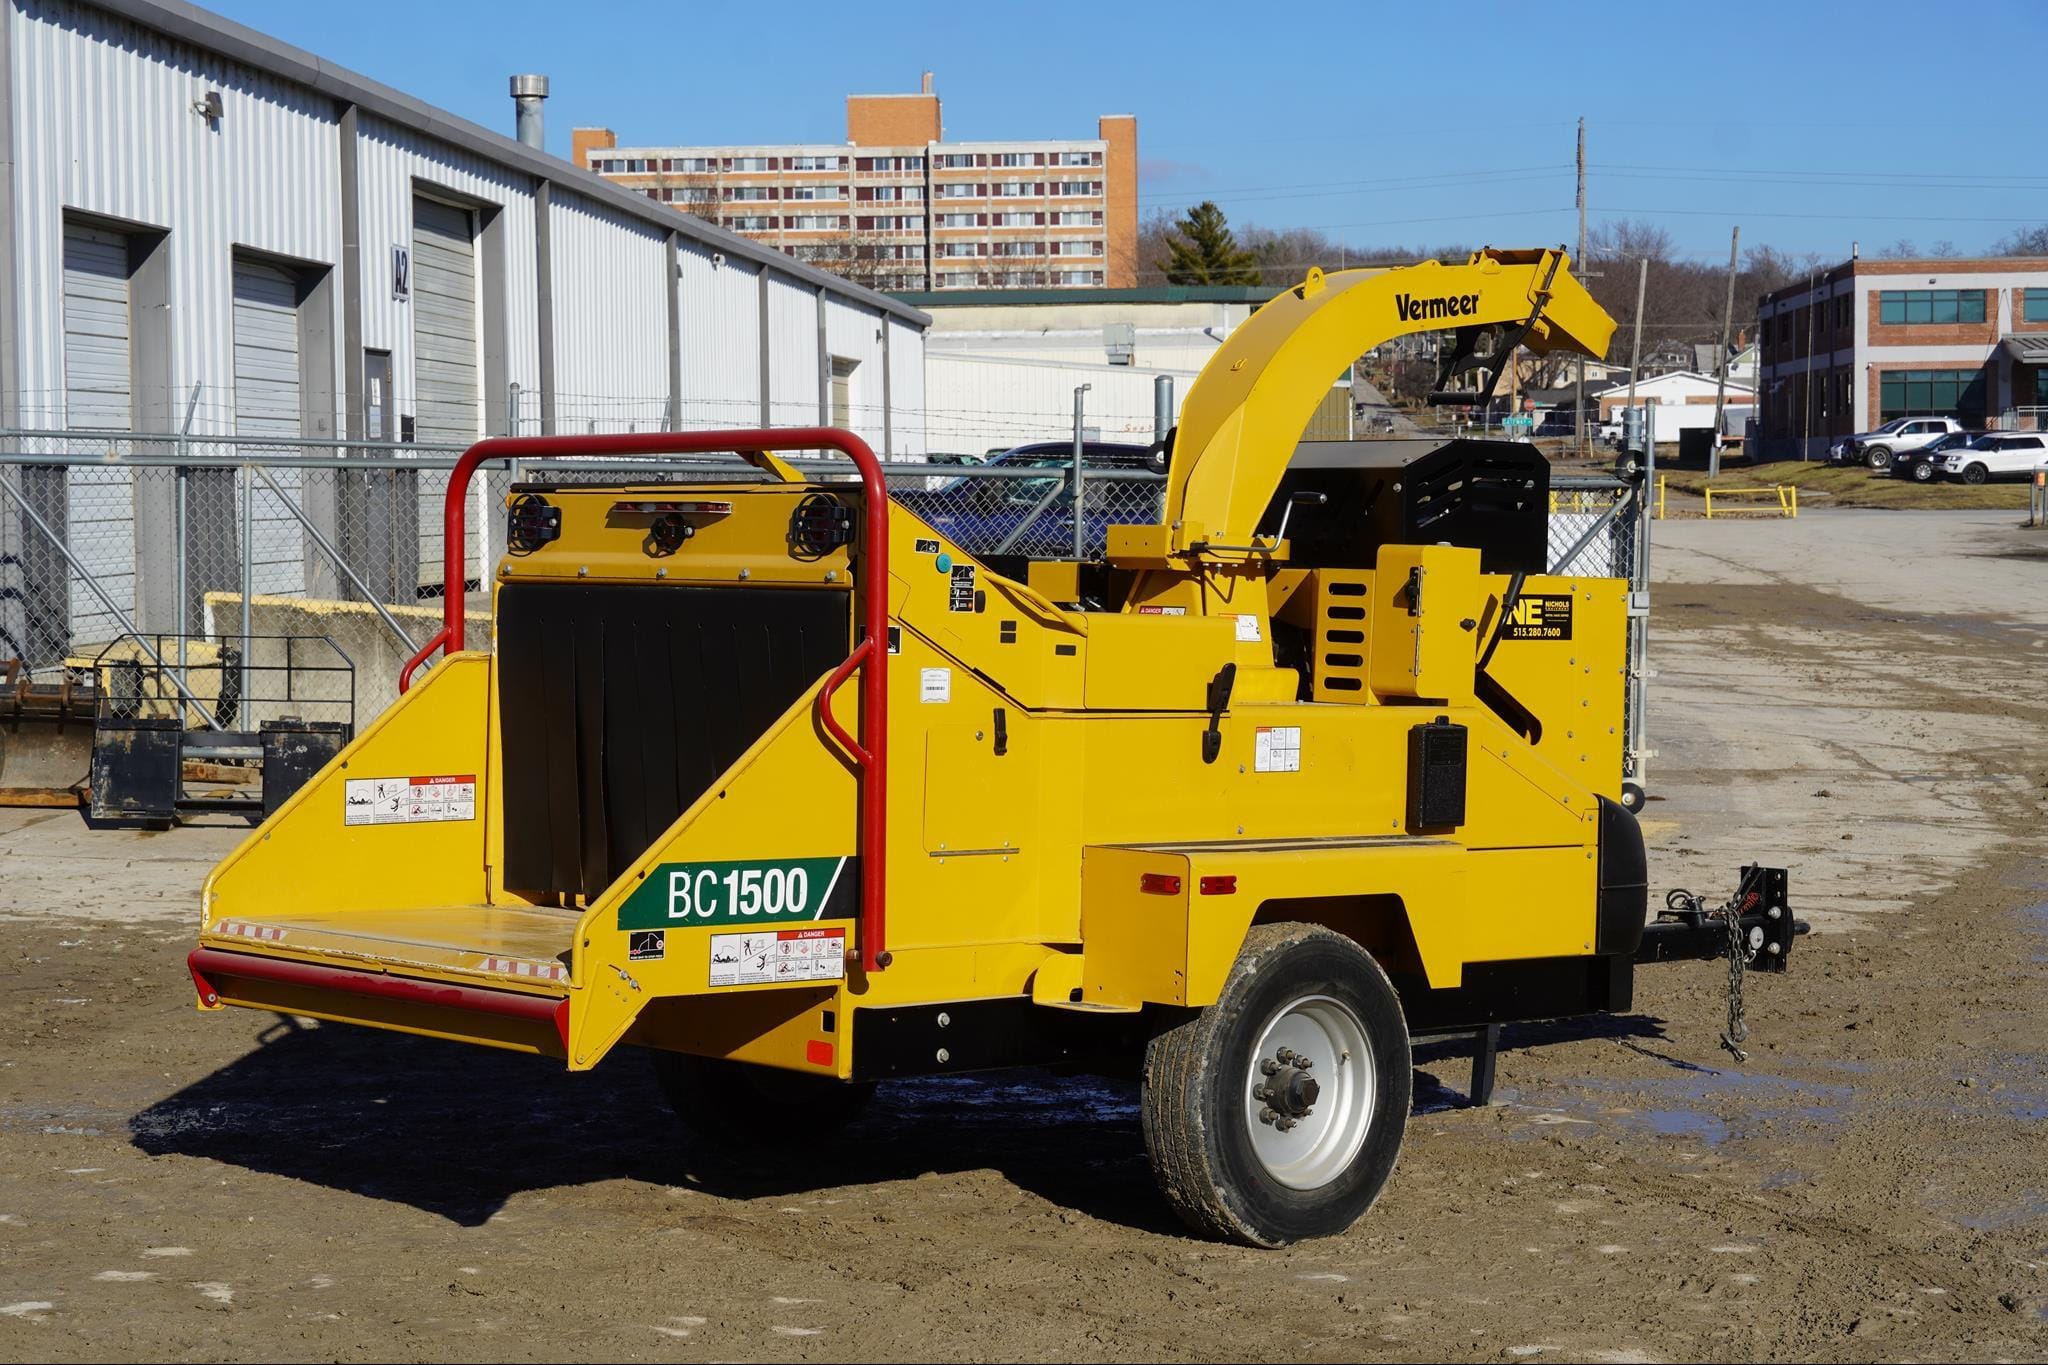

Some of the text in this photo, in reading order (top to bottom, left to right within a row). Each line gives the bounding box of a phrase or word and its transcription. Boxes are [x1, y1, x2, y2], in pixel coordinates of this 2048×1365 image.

[395, 249, 408, 295] A2
[1395, 293, 1479, 321] Vermeer
[1513, 627, 1561, 637] 515.280.7600
[803, 930, 825, 938] DANGER
